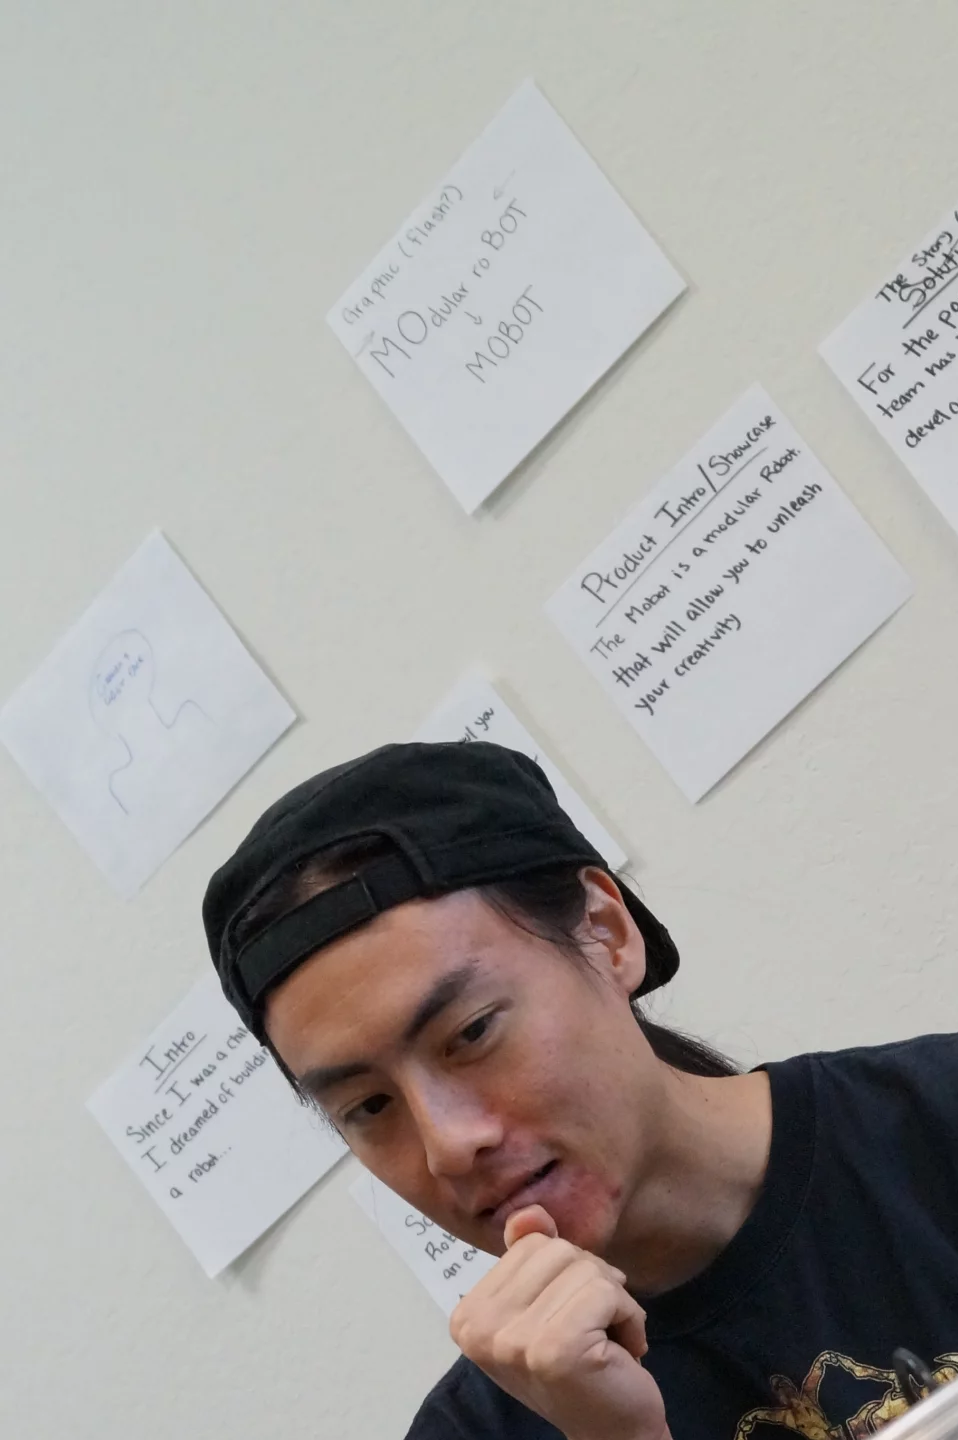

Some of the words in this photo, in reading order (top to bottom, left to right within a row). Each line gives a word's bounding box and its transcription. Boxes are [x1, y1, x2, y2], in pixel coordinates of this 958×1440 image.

[874, 272, 909, 303] The
[911, 230, 954, 267] Story
[465, 284, 545, 384] MOBOT
[856, 361, 896, 395] For
[902, 328, 940, 361] the
[876, 378, 926, 419] team
[925, 351, 957, 378] has
[580, 535, 658, 604] Product
[590, 632, 626, 660] The
[624, 584, 671, 624] Mobot
[671, 561, 691, 580] is
[692, 546, 706, 558] a
[703, 487, 763, 545] modular
[612, 652, 653, 689] that
[651, 619, 687, 656] will
[685, 584, 726, 622] allow
[722, 558, 750, 586] you
[745, 538, 769, 556] to
[766, 481, 823, 535] unleash
[634, 679, 671, 717] your
[674, 613, 742, 676] creativity
[139, 1030, 196, 1081] Intro
[126, 1107, 174, 1145] Since
[165, 1080, 192, 1108] I
[191, 1062, 217, 1088] was
[216, 1051, 228, 1061] a
[141, 1145, 167, 1173] I
[170, 1104, 220, 1156] dreamed
[218, 1082, 234, 1104] of
[169, 1186, 183, 1200] a
[443, 1262, 462, 1280] an
